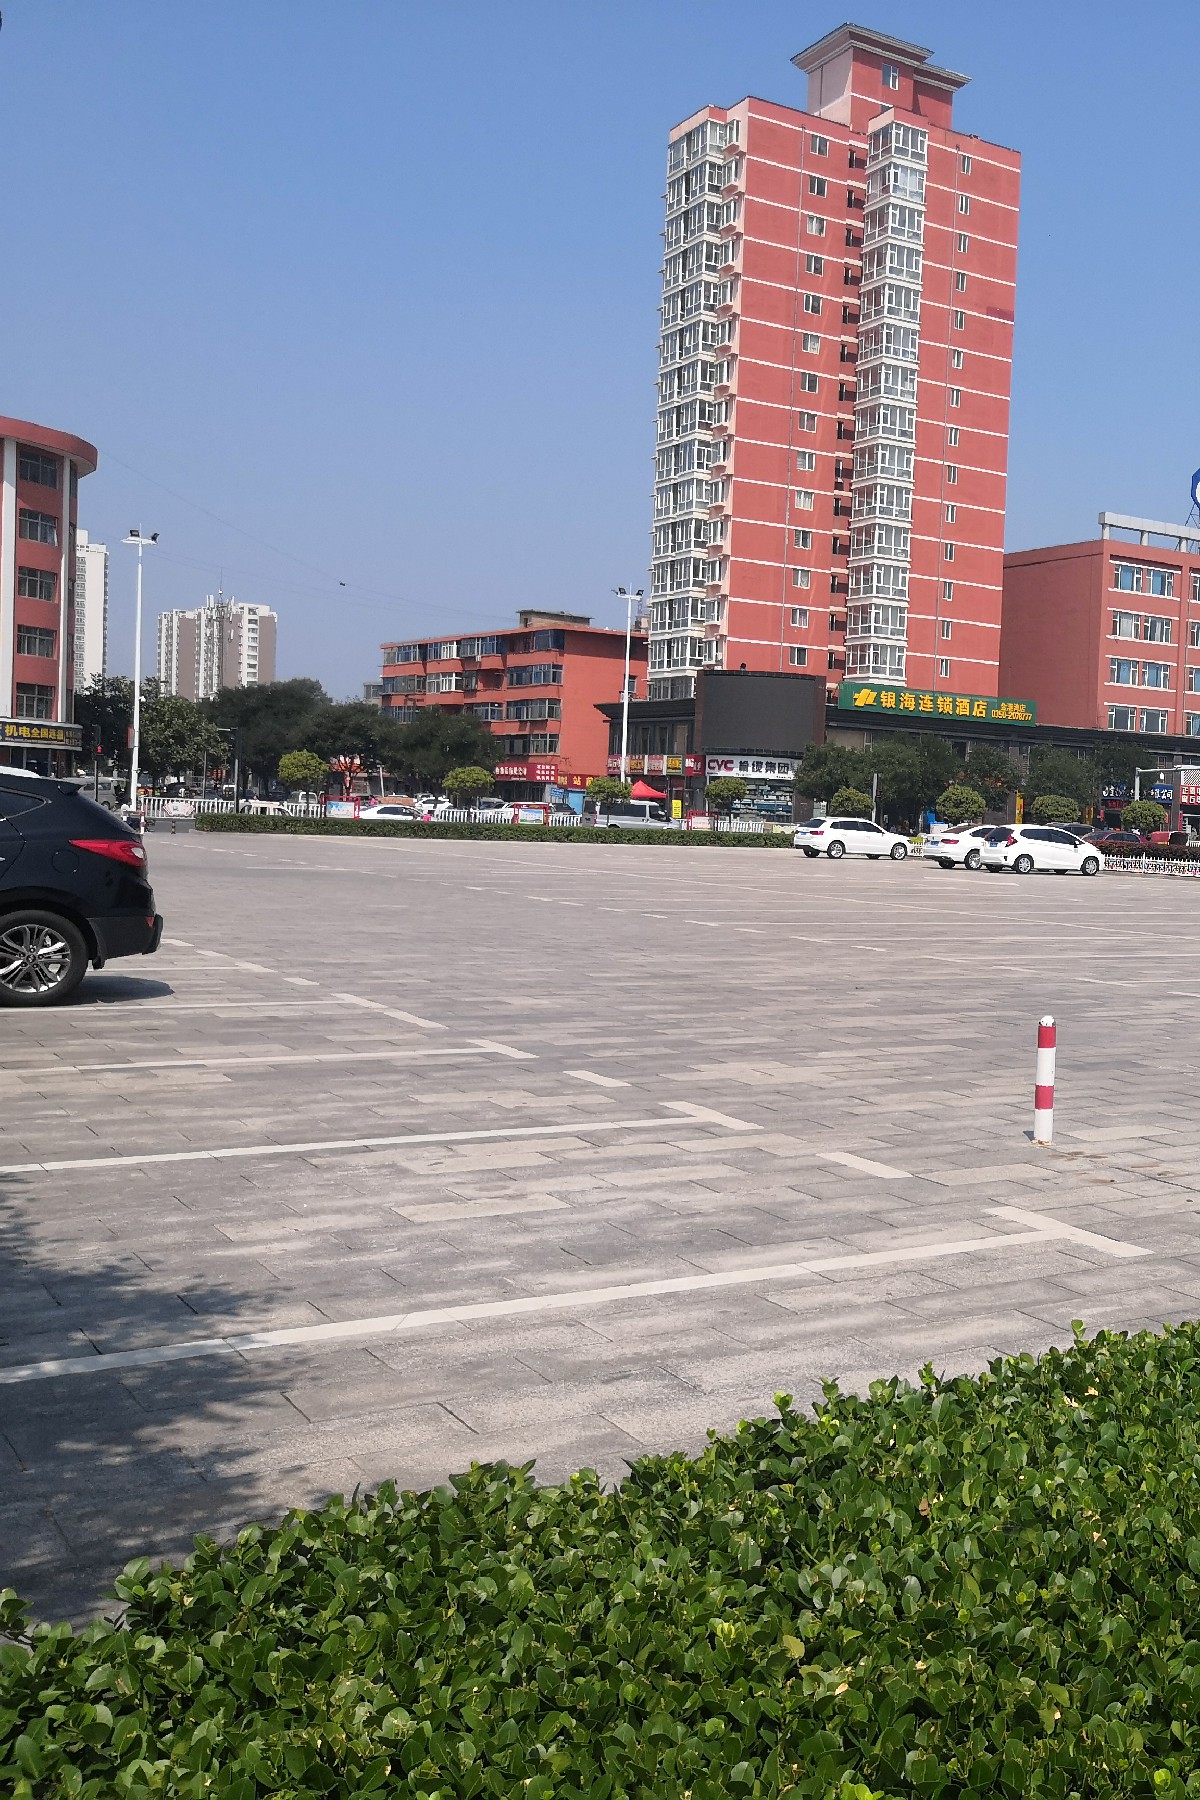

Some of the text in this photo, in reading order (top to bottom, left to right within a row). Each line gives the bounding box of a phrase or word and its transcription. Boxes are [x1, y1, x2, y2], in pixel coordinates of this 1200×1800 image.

[880, 690, 988, 718] 银海连锁酒店
